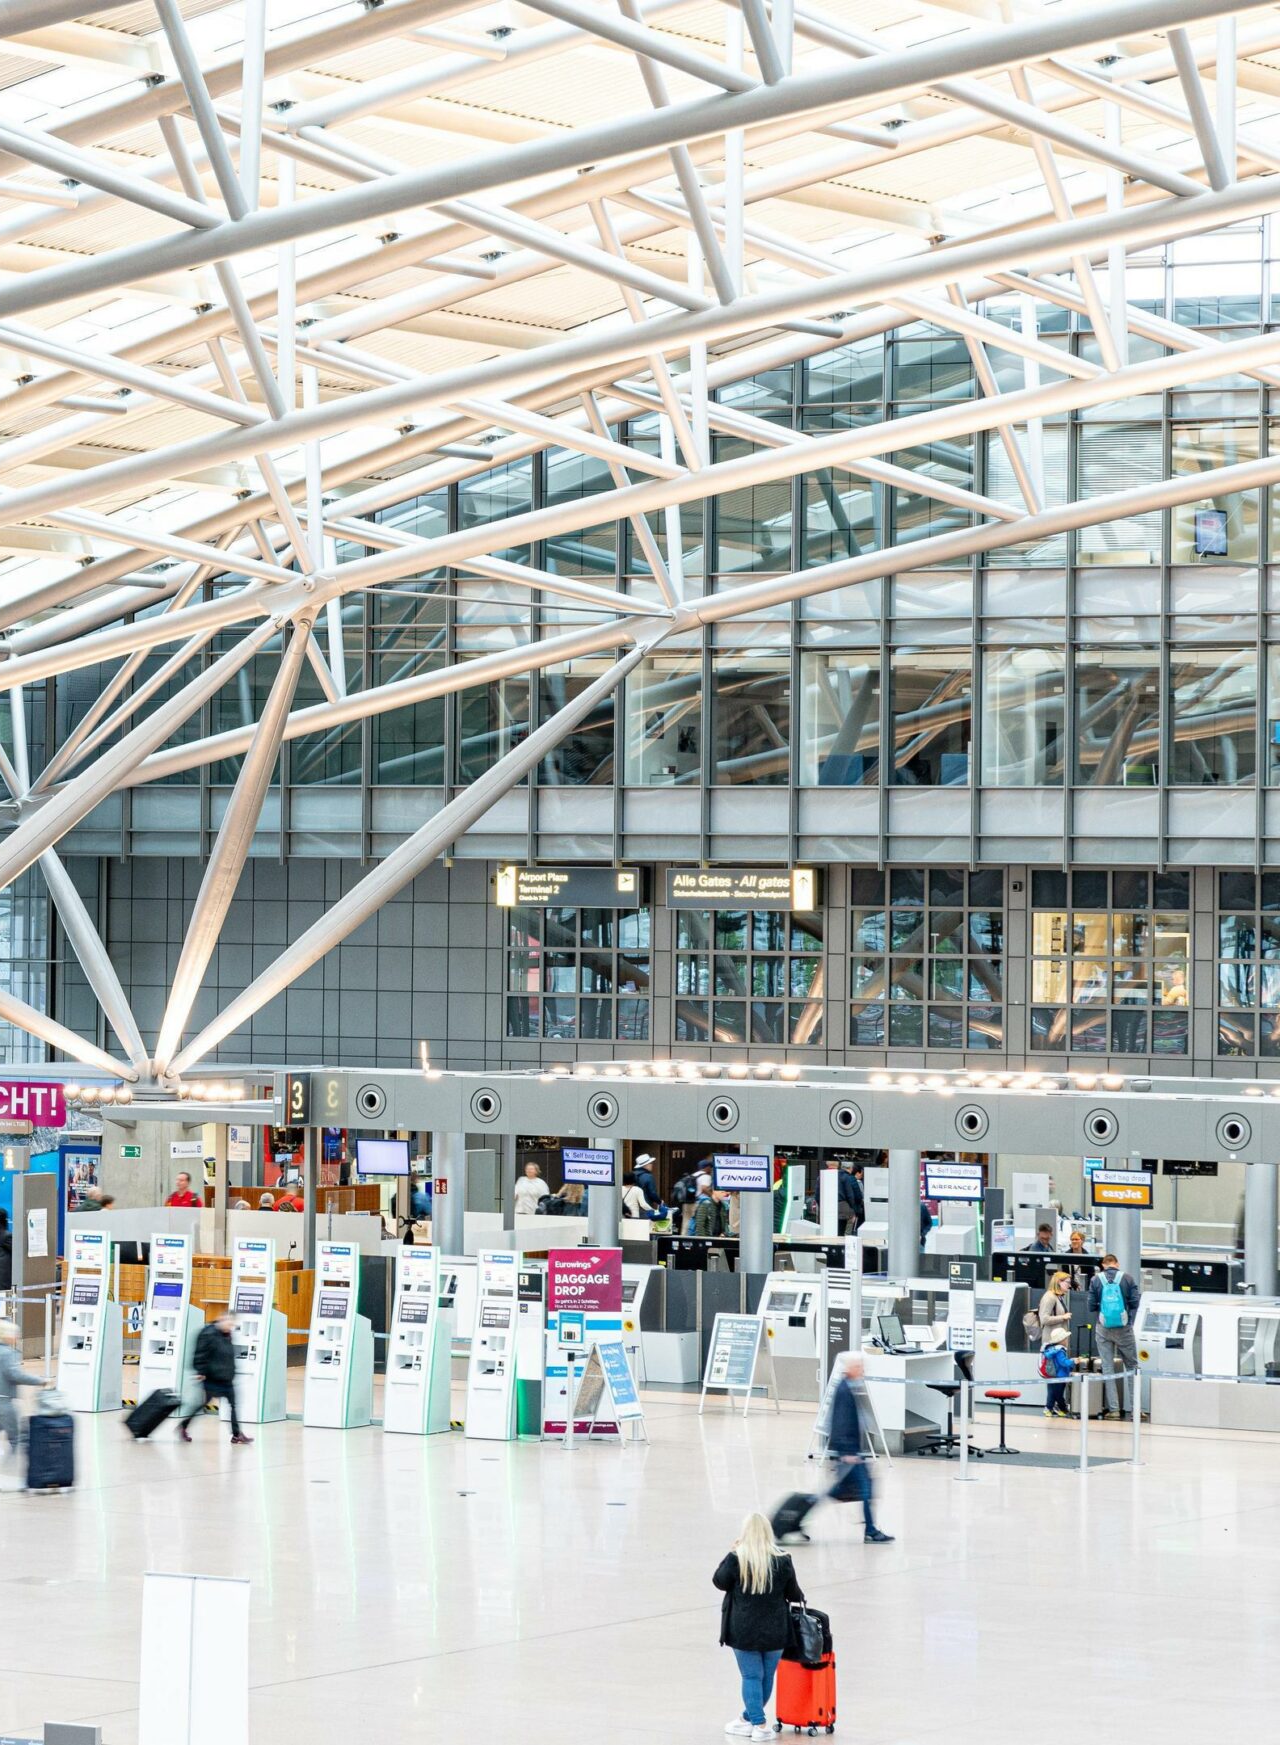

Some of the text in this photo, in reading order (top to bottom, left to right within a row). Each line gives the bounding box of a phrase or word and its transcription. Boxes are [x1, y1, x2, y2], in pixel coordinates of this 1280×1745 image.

[519, 872, 569, 882] Airport Plaza
[673, 875, 790, 889] Alle Gates All gates
[519, 884, 560, 894] Terminal 2
[292, 1081, 303, 1110] 3
[584, 1153, 595, 1161] bag
[596, 1153, 609, 1162] drop
[737, 1159, 748, 1167] bag
[750, 1159, 763, 1167] drop
[963, 1168, 977, 1176] drop
[720, 1174, 763, 1182] FINNAIR
[1118, 1174, 1129, 1182] bag
[1131, 1174, 1146, 1182] drop
[1102, 1189, 1142, 1199] easyJet
[554, 1261, 591, 1270] Eurowings
[554, 1274, 610, 1284] BAGGAGE
[554, 1286, 586, 1296] DROP
